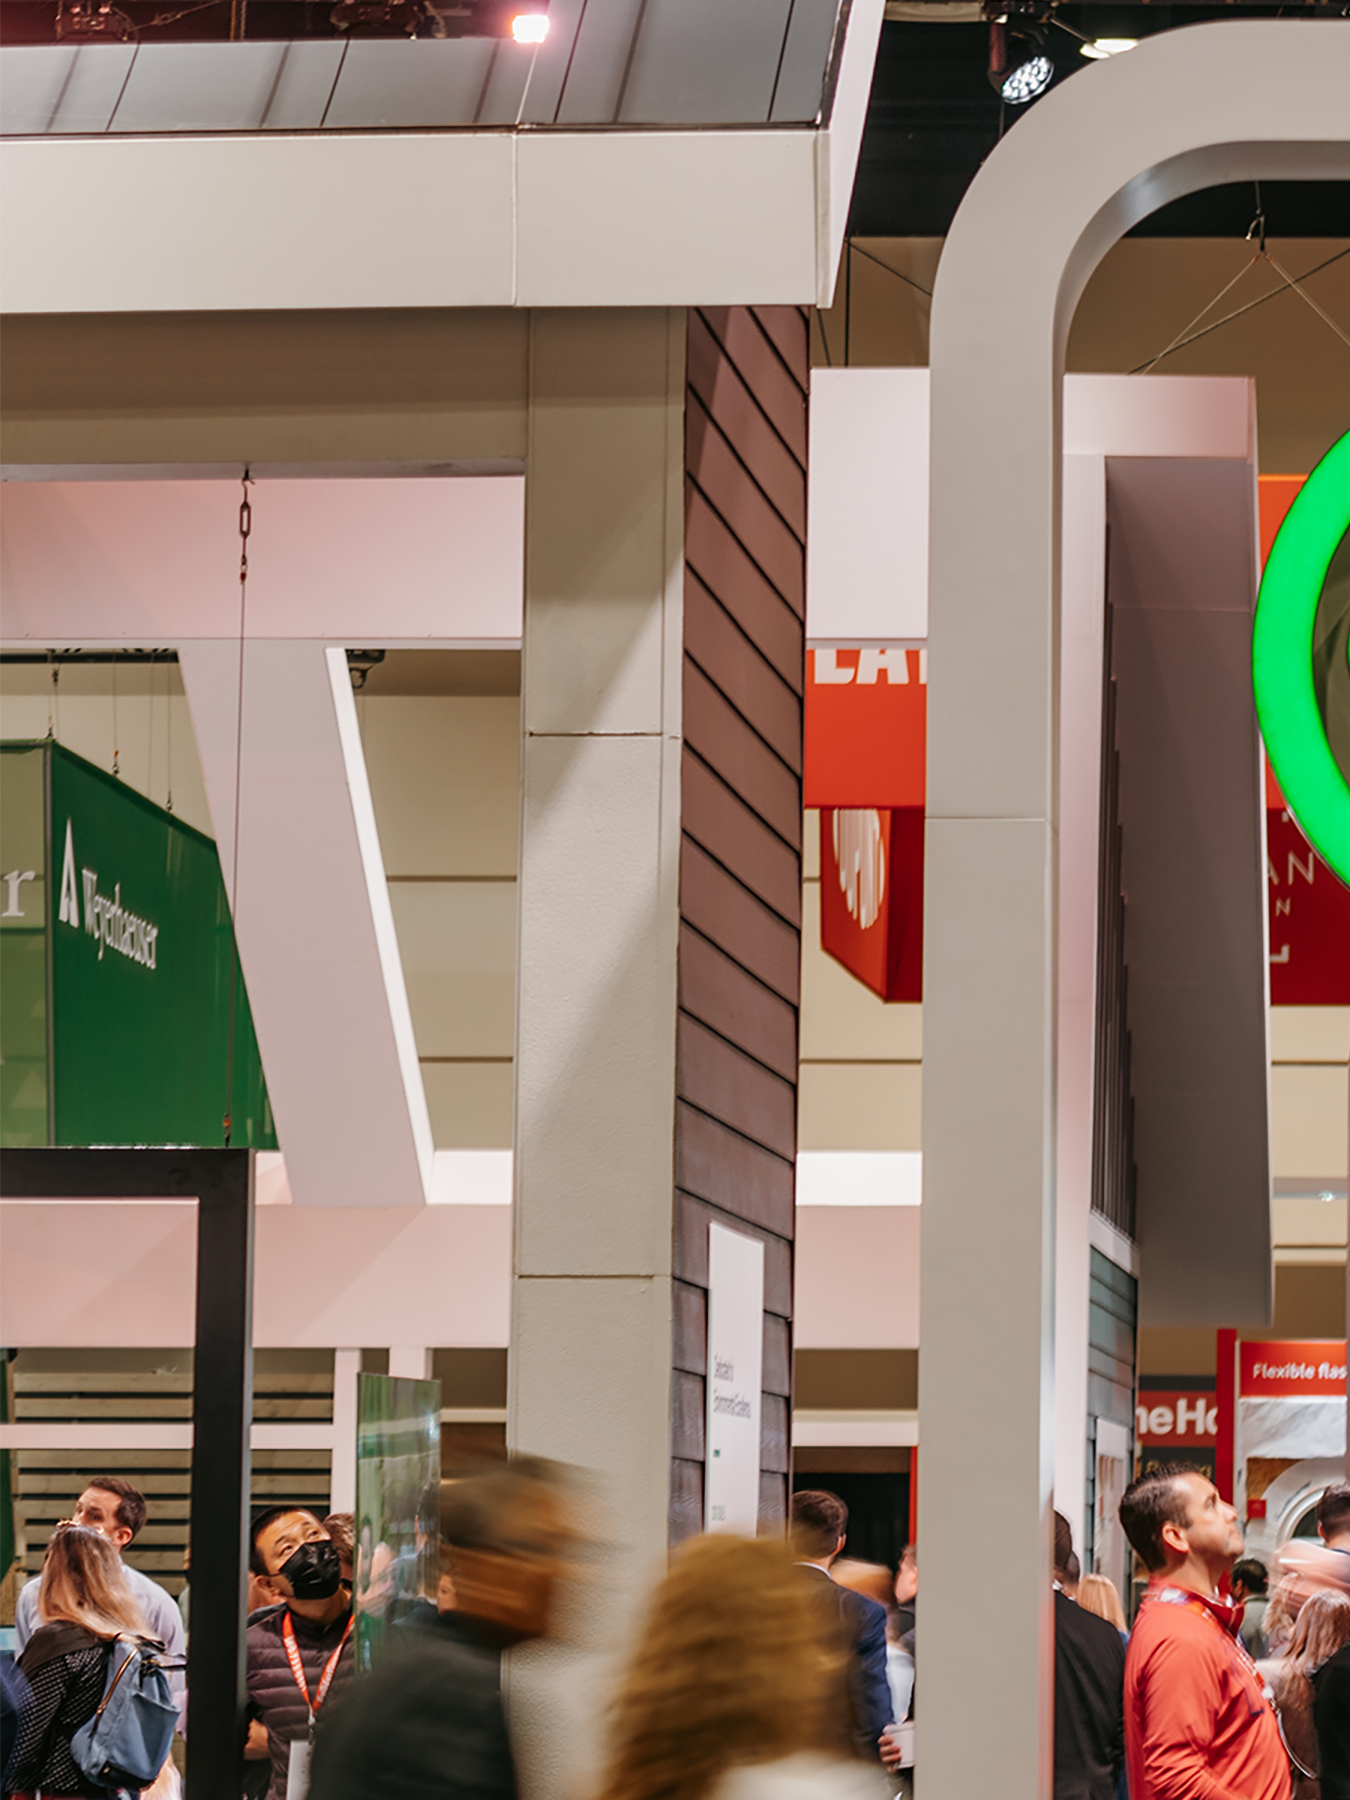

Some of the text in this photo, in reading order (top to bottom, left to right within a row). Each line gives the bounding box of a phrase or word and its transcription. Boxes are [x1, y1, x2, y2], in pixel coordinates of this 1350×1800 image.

[1, 869, 36, 917] r
[1253, 1362, 1316, 1380] Flexible
[1318, 1361, 1348, 1380] flas
